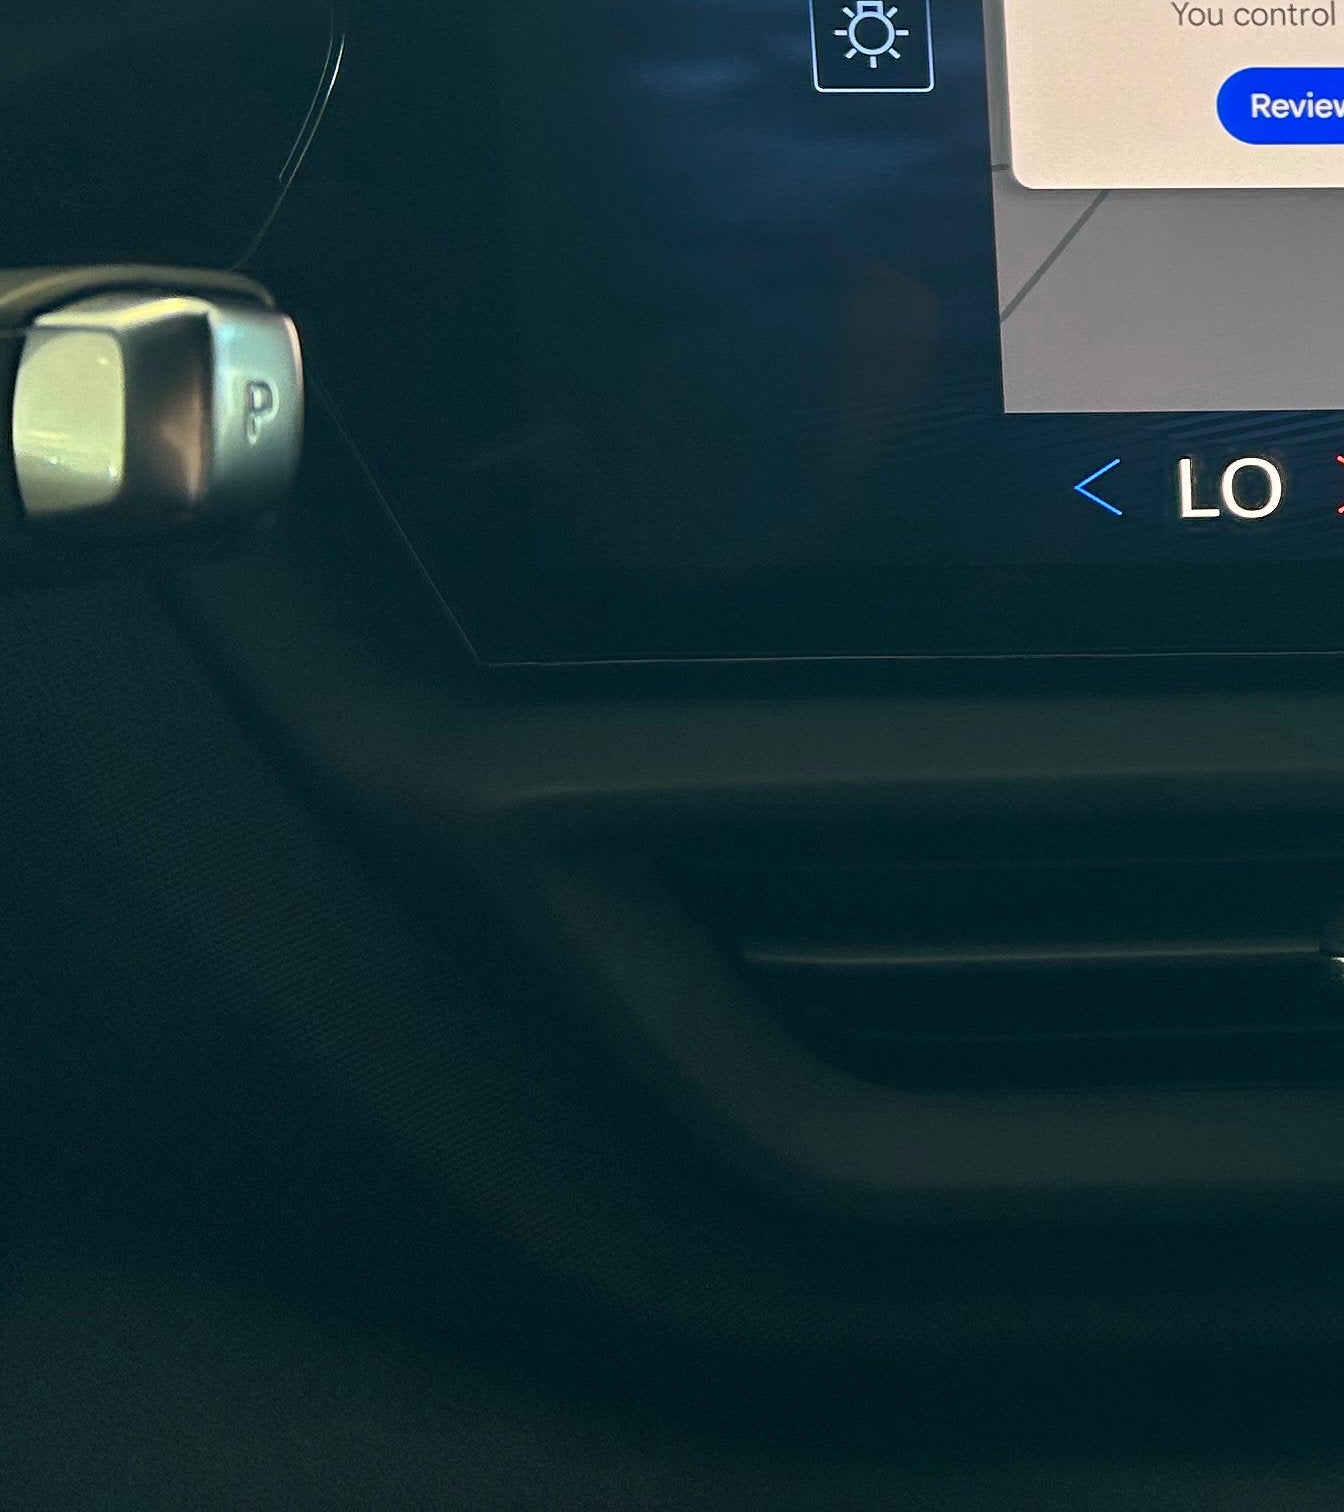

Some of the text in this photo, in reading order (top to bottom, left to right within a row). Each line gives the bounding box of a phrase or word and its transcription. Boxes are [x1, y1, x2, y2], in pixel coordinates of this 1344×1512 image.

[1171, 2, 1225, 28] You
[1234, 1, 1337, 28] control
[247, 379, 280, 445] P
[1178, 457, 1284, 521] LO
